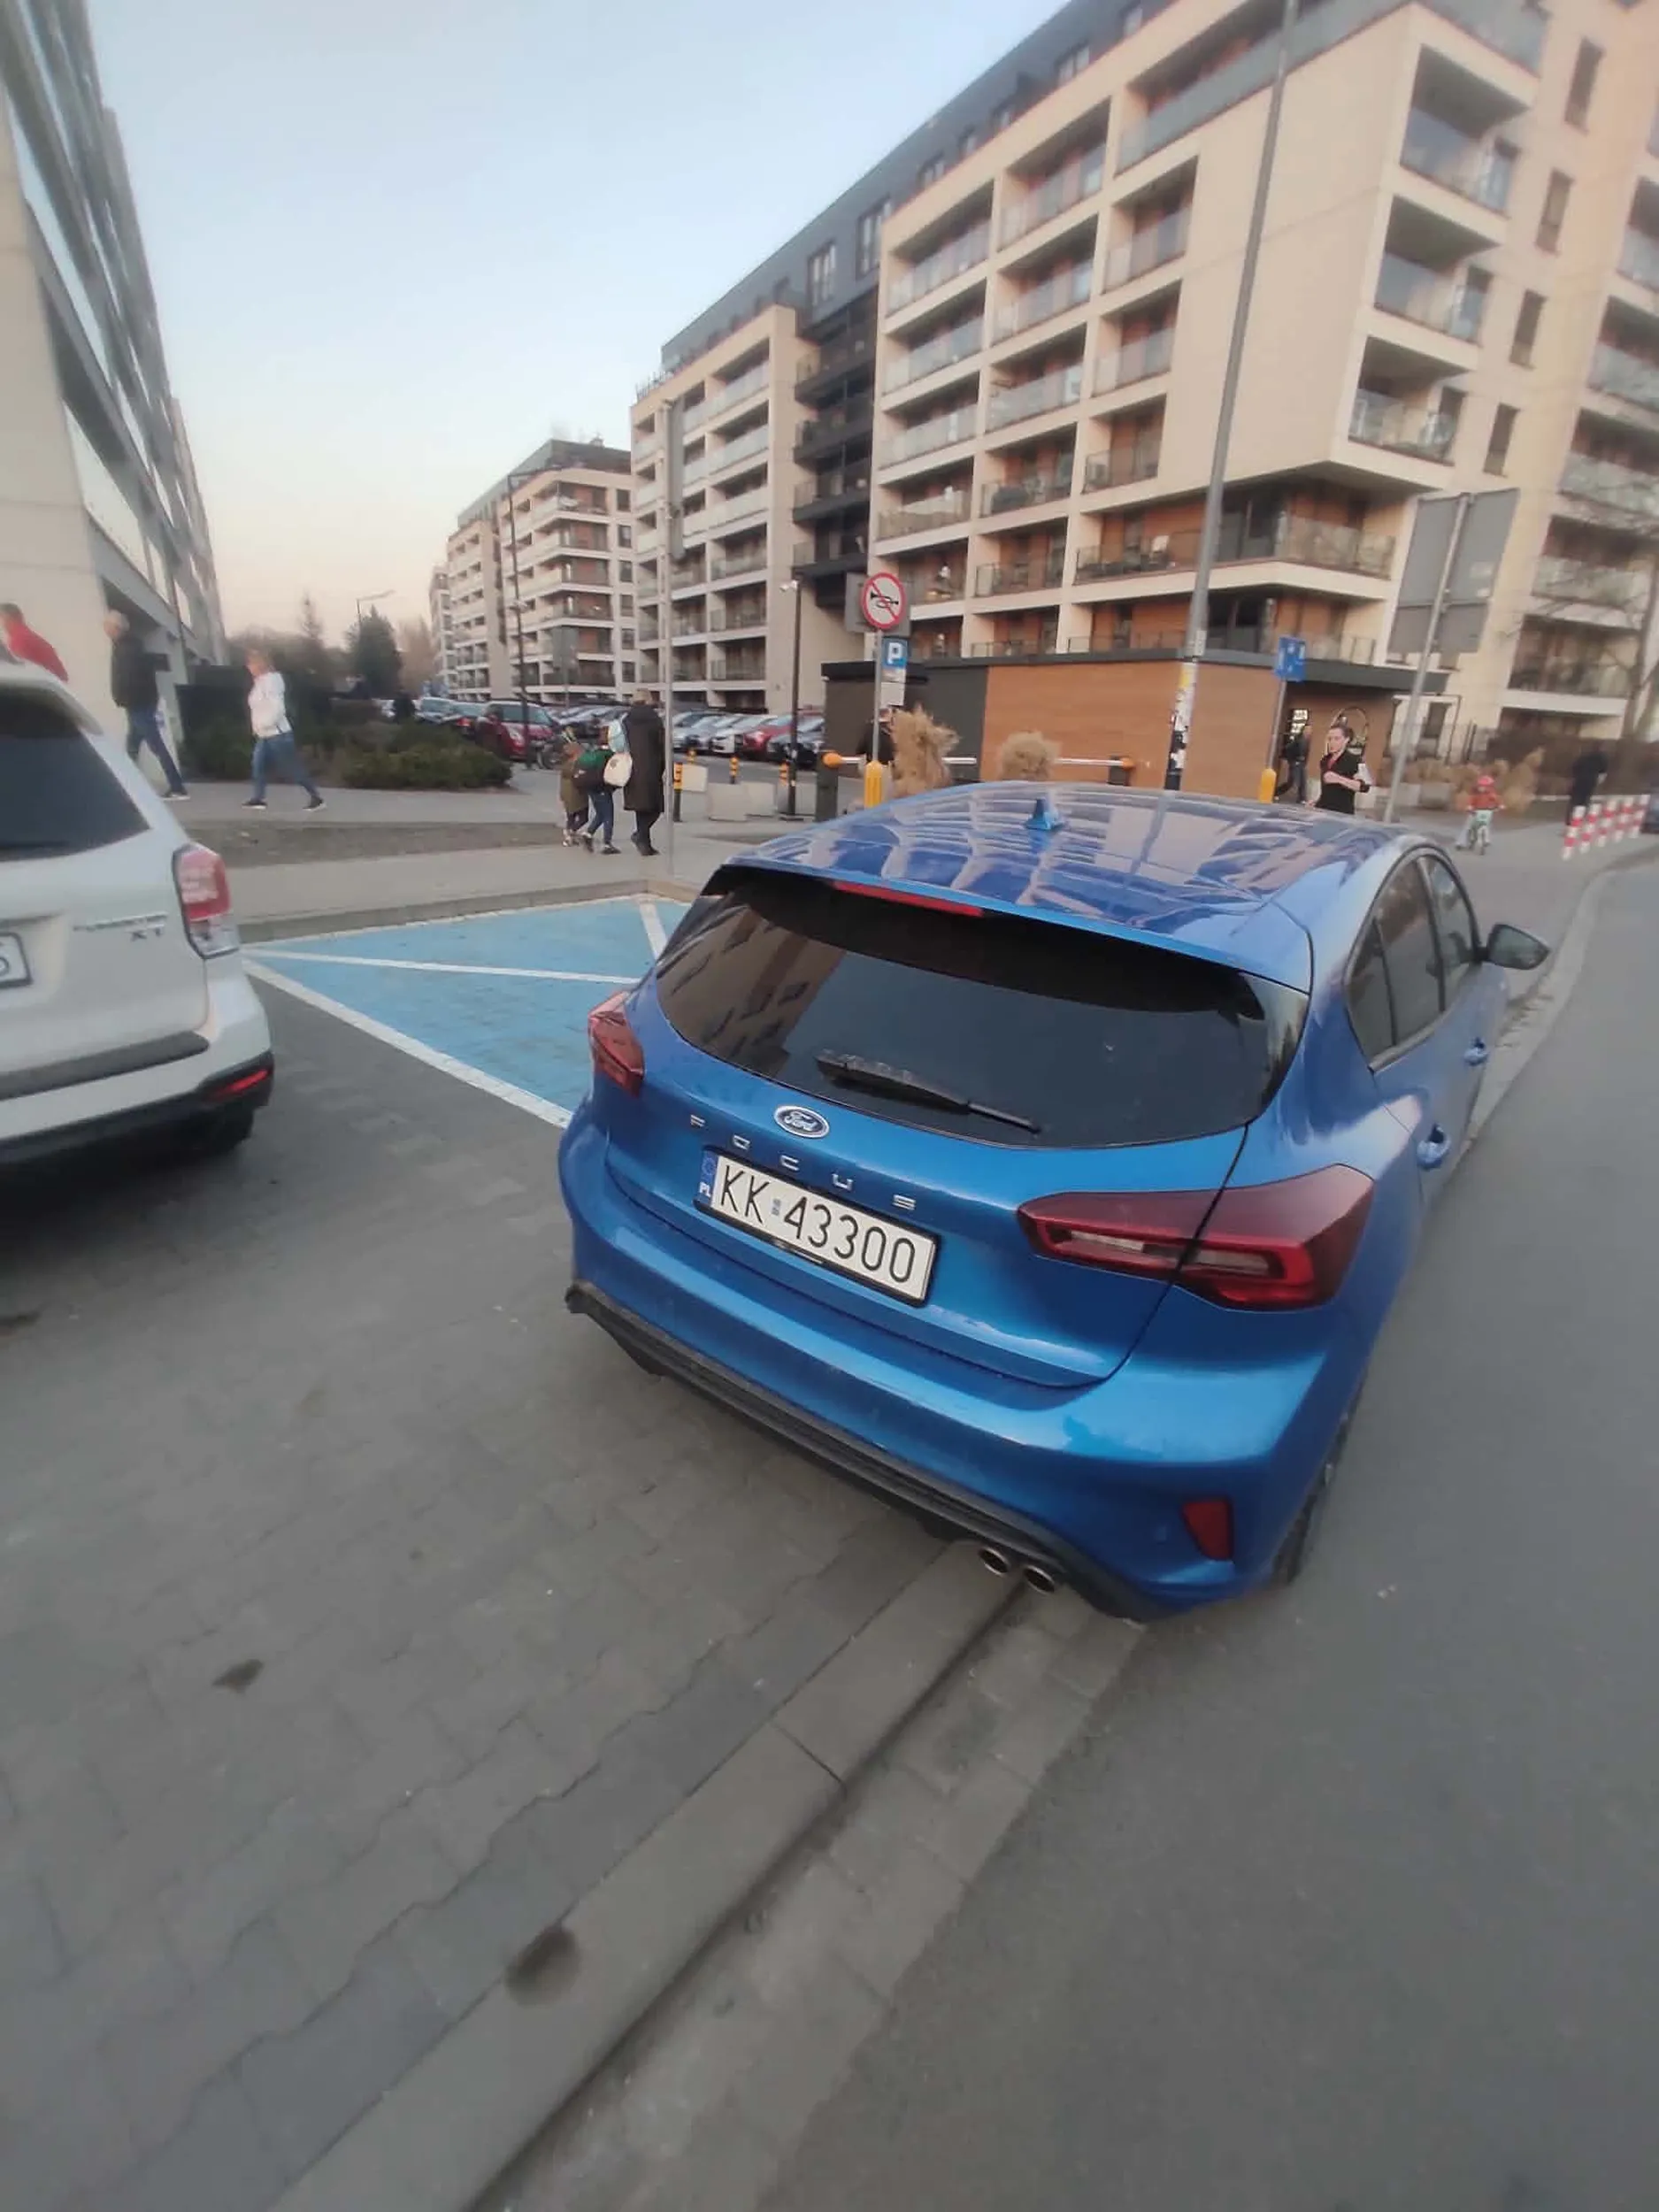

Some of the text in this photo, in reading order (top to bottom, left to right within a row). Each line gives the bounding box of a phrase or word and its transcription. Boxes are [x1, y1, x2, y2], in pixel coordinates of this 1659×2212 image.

[887, 642, 902, 664] P
[720, 1164, 916, 1283] KK 43300
